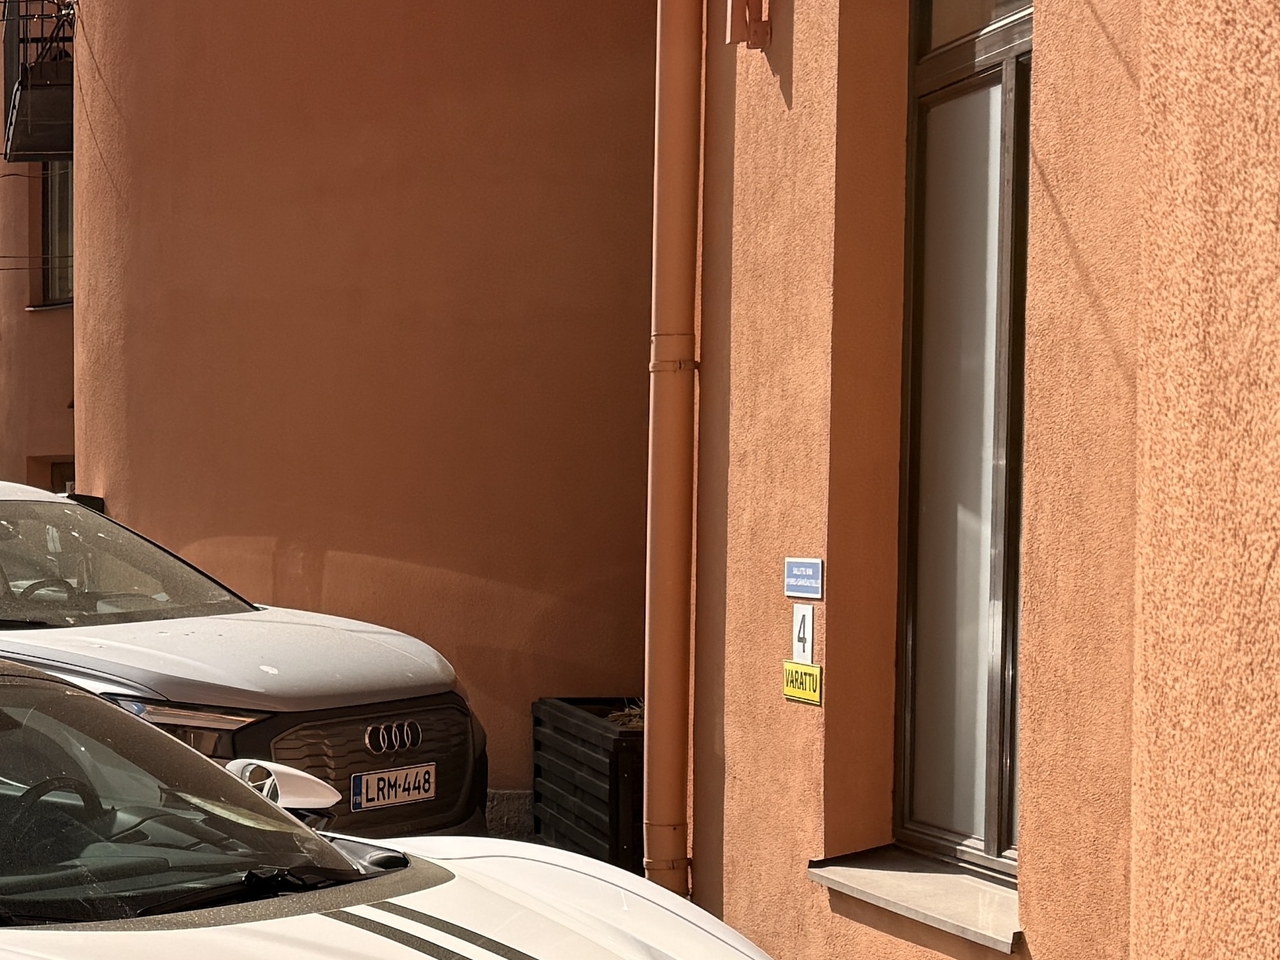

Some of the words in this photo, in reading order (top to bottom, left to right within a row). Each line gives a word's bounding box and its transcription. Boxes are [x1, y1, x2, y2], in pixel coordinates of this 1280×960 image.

[797, 614, 807, 654] 4
[785, 668, 818, 693] VARATTU
[366, 770, 431, 803] LRM-448
